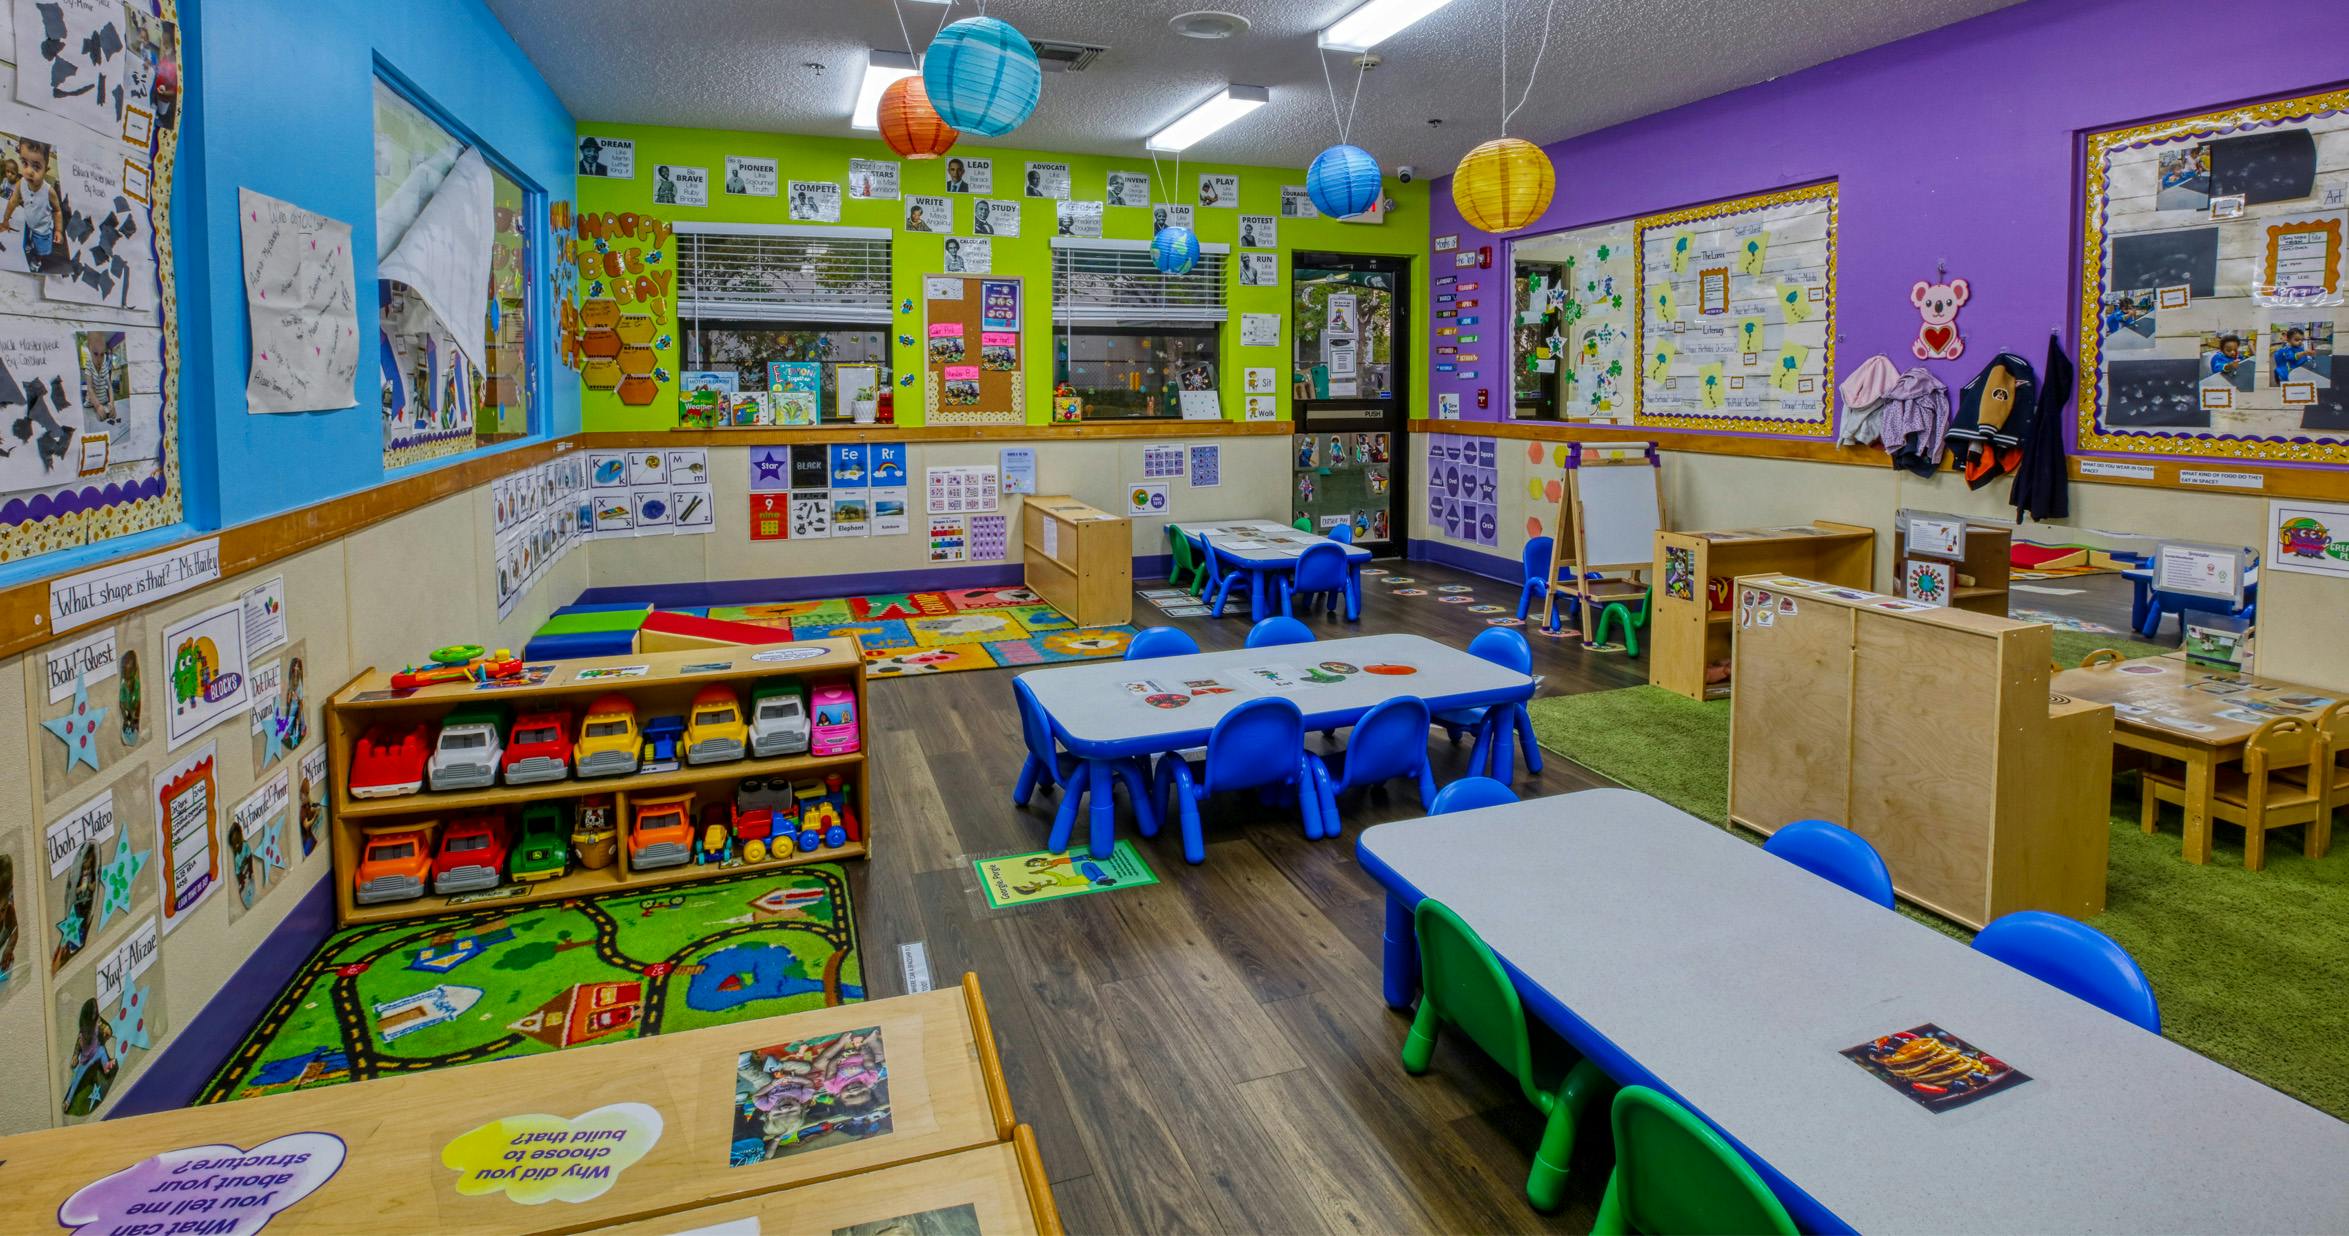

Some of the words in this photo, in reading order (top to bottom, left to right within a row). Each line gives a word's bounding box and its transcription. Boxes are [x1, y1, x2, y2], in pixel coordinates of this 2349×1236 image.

[601, 139, 632, 149] DREAM
[739, 164, 774, 173] PIONEER
[967, 161, 989, 169] LEAD
[676, 175, 703, 183] BRAVE
[1216, 178, 1235, 186] PLAY
[793, 183, 837, 193] COMPETE
[915, 198, 944, 206] WRITE
[2324, 189, 2344, 205] Art
[991, 204, 1017, 212] STUDY
[1242, 216, 1273, 224] PROTEST
[578, 212, 672, 249] HAPPY
[1262, 378, 1272, 388] Sit
[841, 448, 859, 460] Ee
[881, 448, 895, 460] Rr
[593, 459, 600, 468] K
[632, 456, 639, 465] L
[761, 462, 779, 470] Star
[796, 461, 822, 470] BLACK
[619, 476, 625, 485] k
[599, 499, 606, 507] X
[765, 498, 774, 511] 9
[626, 519, 632, 527] x
[1482, 521, 1494, 530] Circle
[100, 582, 133, 604] shape
[136, 576, 146, 593] is
[194, 550, 218, 577] Hailey
[210, 674, 238, 702] BLOCKS
[510, 1132, 569, 1146] that?
[570, 1129, 627, 1143] build
[503, 1150, 526, 1162] to
[530, 1147, 611, 1160] choose
[171, 1153, 312, 1175] structure?
[475, 1165, 523, 1180] you
[518, 1167, 558, 1181] did
[561, 1163, 610, 1180] Why
[148, 1175, 219, 1193] your
[214, 1173, 294, 1192] about
[221, 1191, 279, 1210] you
[126, 1200, 172, 1215] me
[167, 1199, 218, 1217] tell
[110, 1223, 164, 1236] can
[171, 1218, 240, 1236] What
